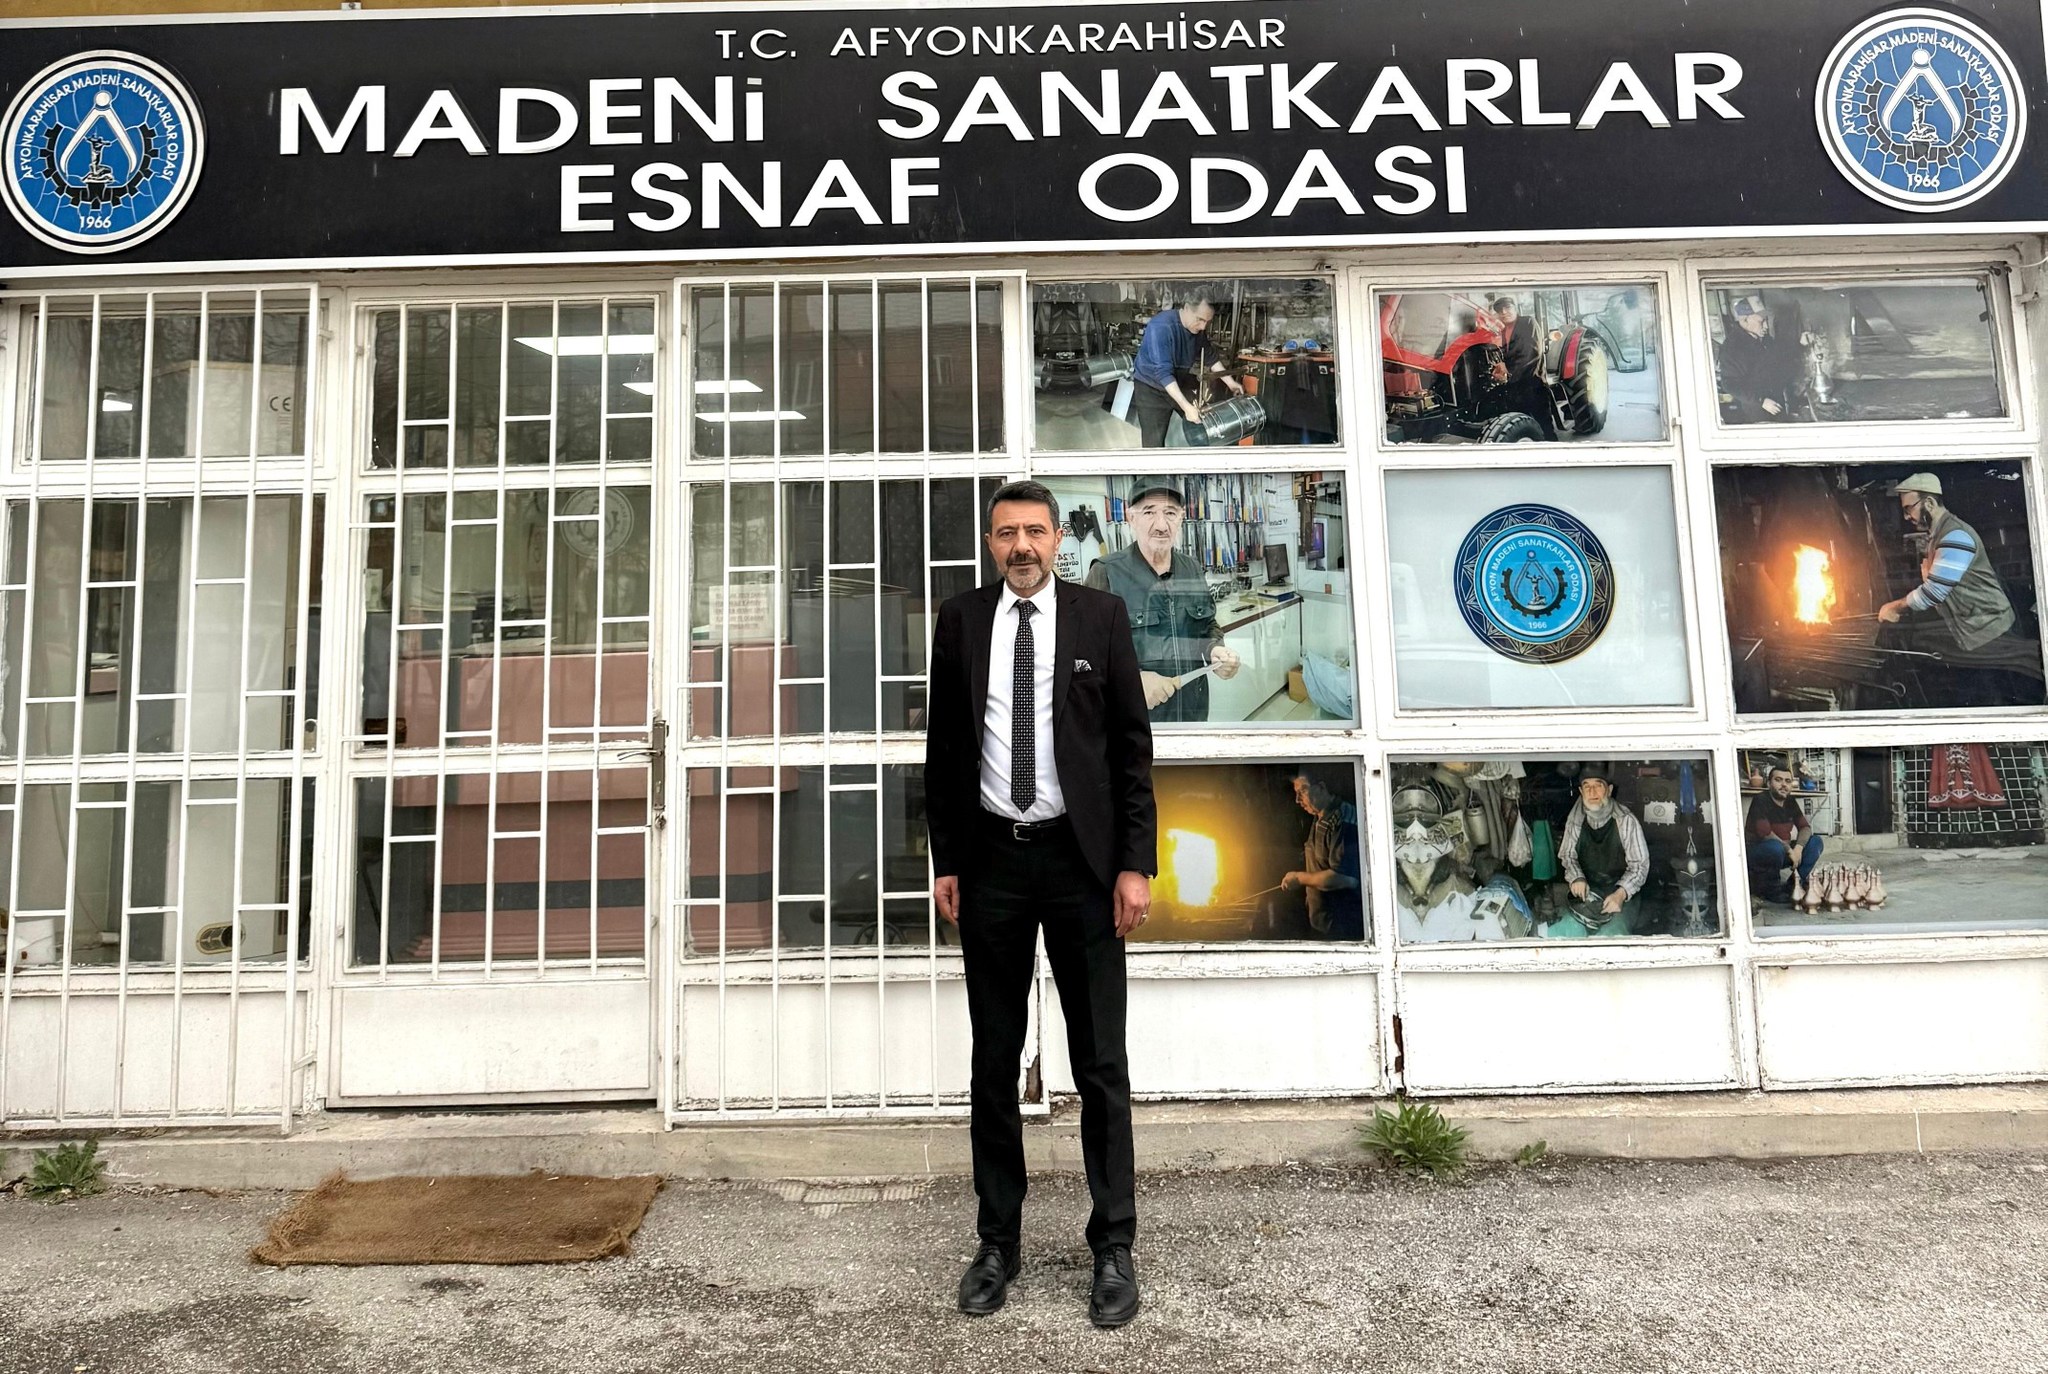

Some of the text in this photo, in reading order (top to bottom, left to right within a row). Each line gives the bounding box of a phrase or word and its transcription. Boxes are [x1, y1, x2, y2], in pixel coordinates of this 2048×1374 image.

[716, 12, 1286, 59] T.C. AFYONKARAHİSAR
[878, 53, 1745, 143] SANATKARLAR
[1889, 31, 1938, 48] MADENİ
[1940, 36, 1999, 102] SANATKARLAR
[1987, 103, 2003, 142] ODASI
[19, 73, 179, 181] AFYONKARAHİSAR MADENİ SANATKARLAR ODASI
[561, 146, 1467, 232] ESNAF ODASI
[1908, 173, 1940, 188] 1966
[79, 215, 112, 229] 1966
[1489, 572, 1500, 602] AFYON
[1518, 539, 1576, 571] SANATKARLAR
[1528, 621, 1548, 630] 1966
